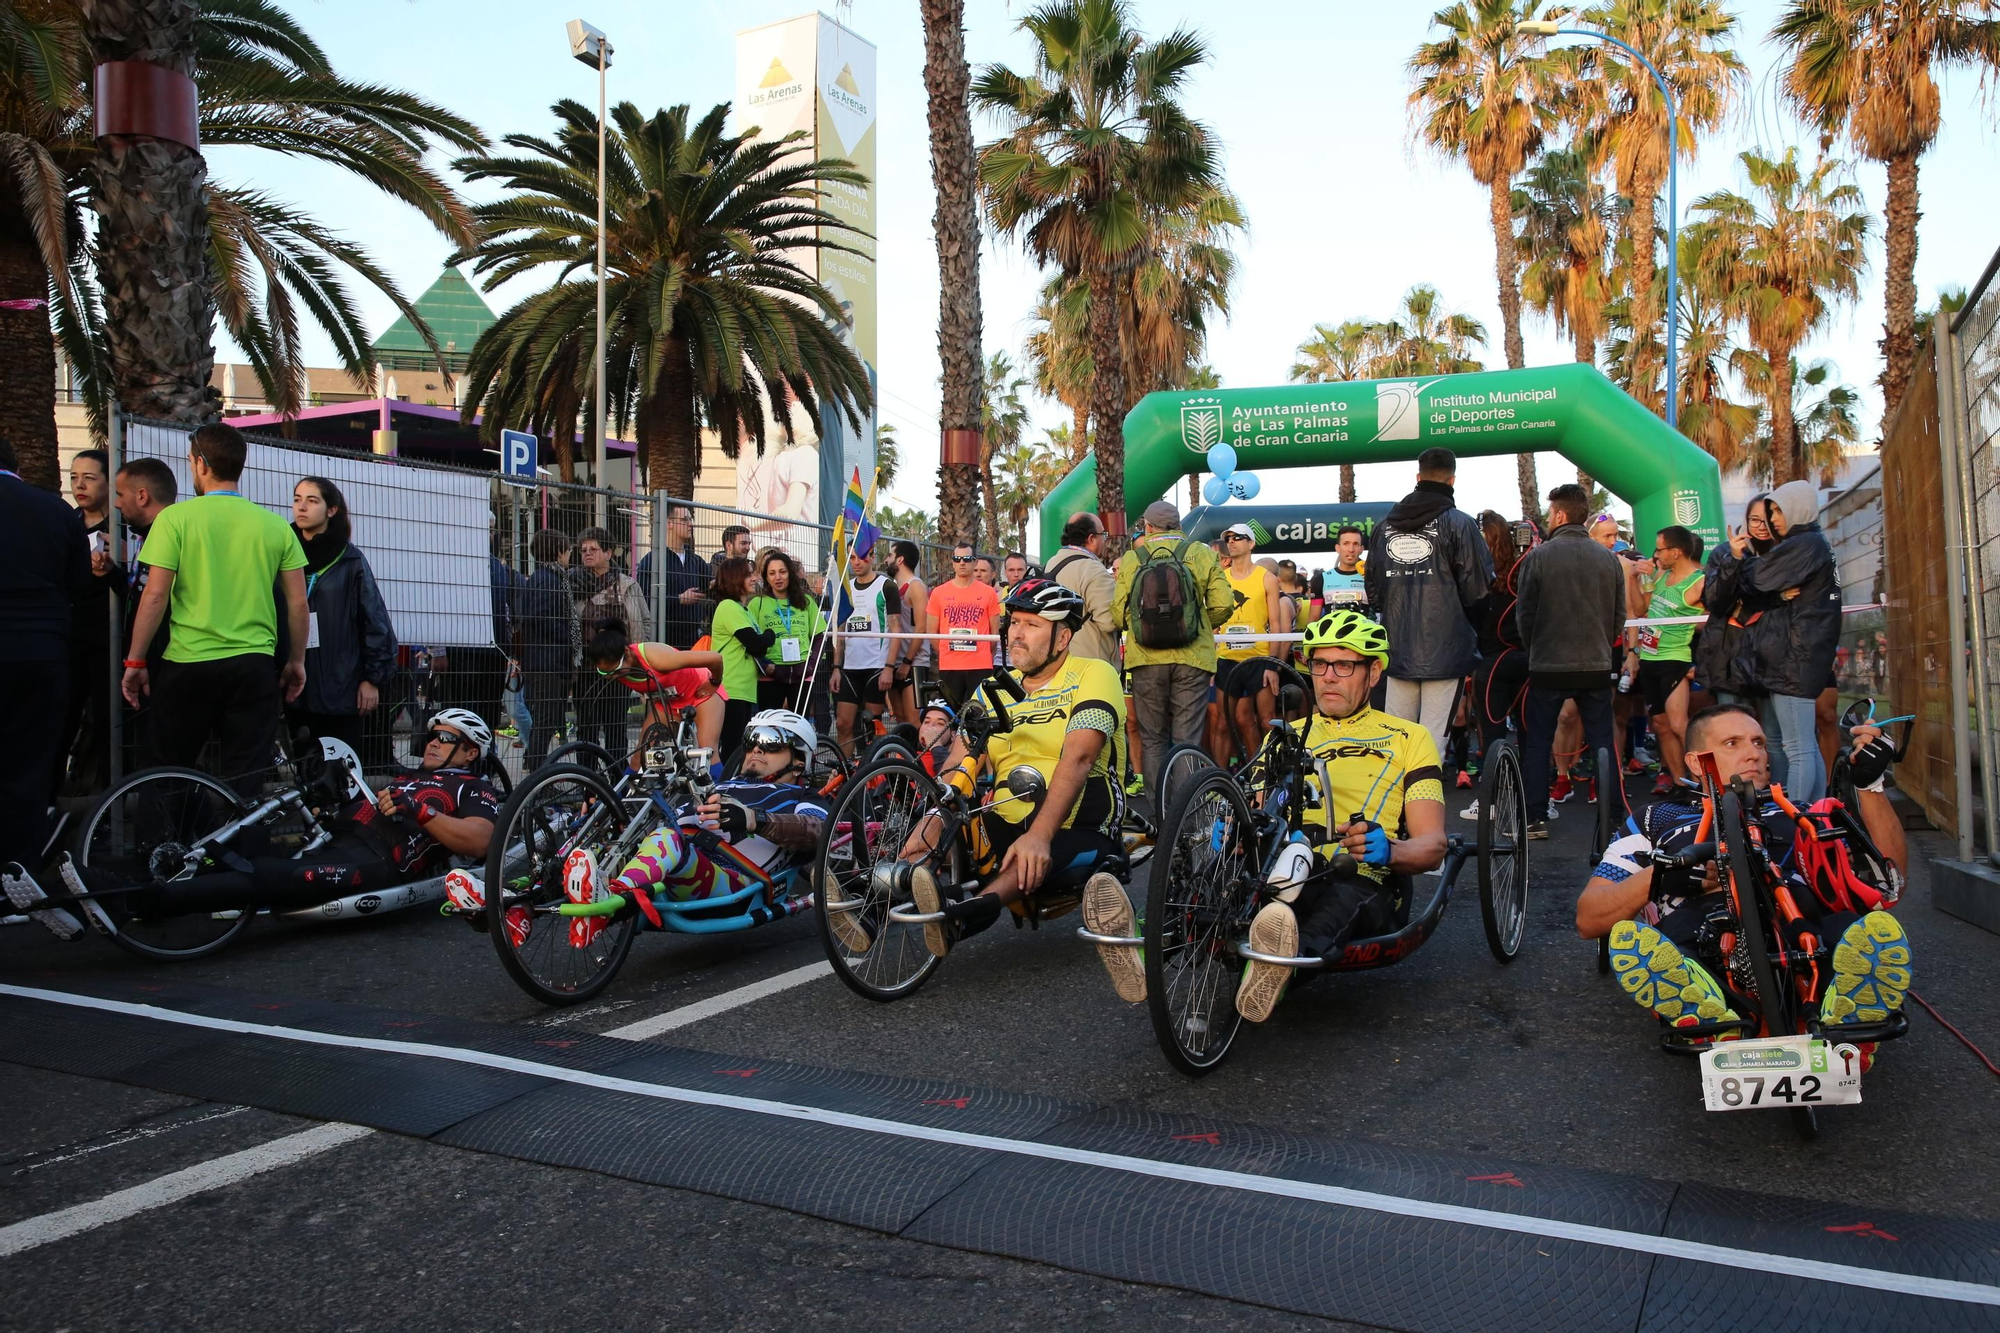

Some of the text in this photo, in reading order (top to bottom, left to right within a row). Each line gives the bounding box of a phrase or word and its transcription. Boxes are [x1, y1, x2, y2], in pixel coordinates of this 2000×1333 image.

[749, 83, 802, 105] Las Arenas
[828, 84, 867, 114] Las Arenas
[824, 258, 838, 271] los
[1430, 387, 1556, 408] Instituto Municipal
[1232, 401, 1348, 420] Ayuntamiento
[1430, 408, 1515, 424] de Deportes
[1233, 415, 1348, 433] de Las Palmas
[1430, 419, 1556, 435] Las Palmas de Gran Canaria
[1233, 429, 1348, 447] de Gran Canaria
[511, 440, 530, 475] P
[944, 606, 984, 618] FINISHER
[851, 622, 868, 630] 3183
[949, 615, 979, 626] PARIS
[355, 899, 382, 908] ICOT
[1742, 1050, 1783, 1060] cajasiete
[1766, 1058, 1796, 1066] MARATÓN
[1812, 1055, 1824, 1068] 3
[1721, 1075, 1822, 1107] 8742
[1838, 1079, 1858, 1087] 8742
